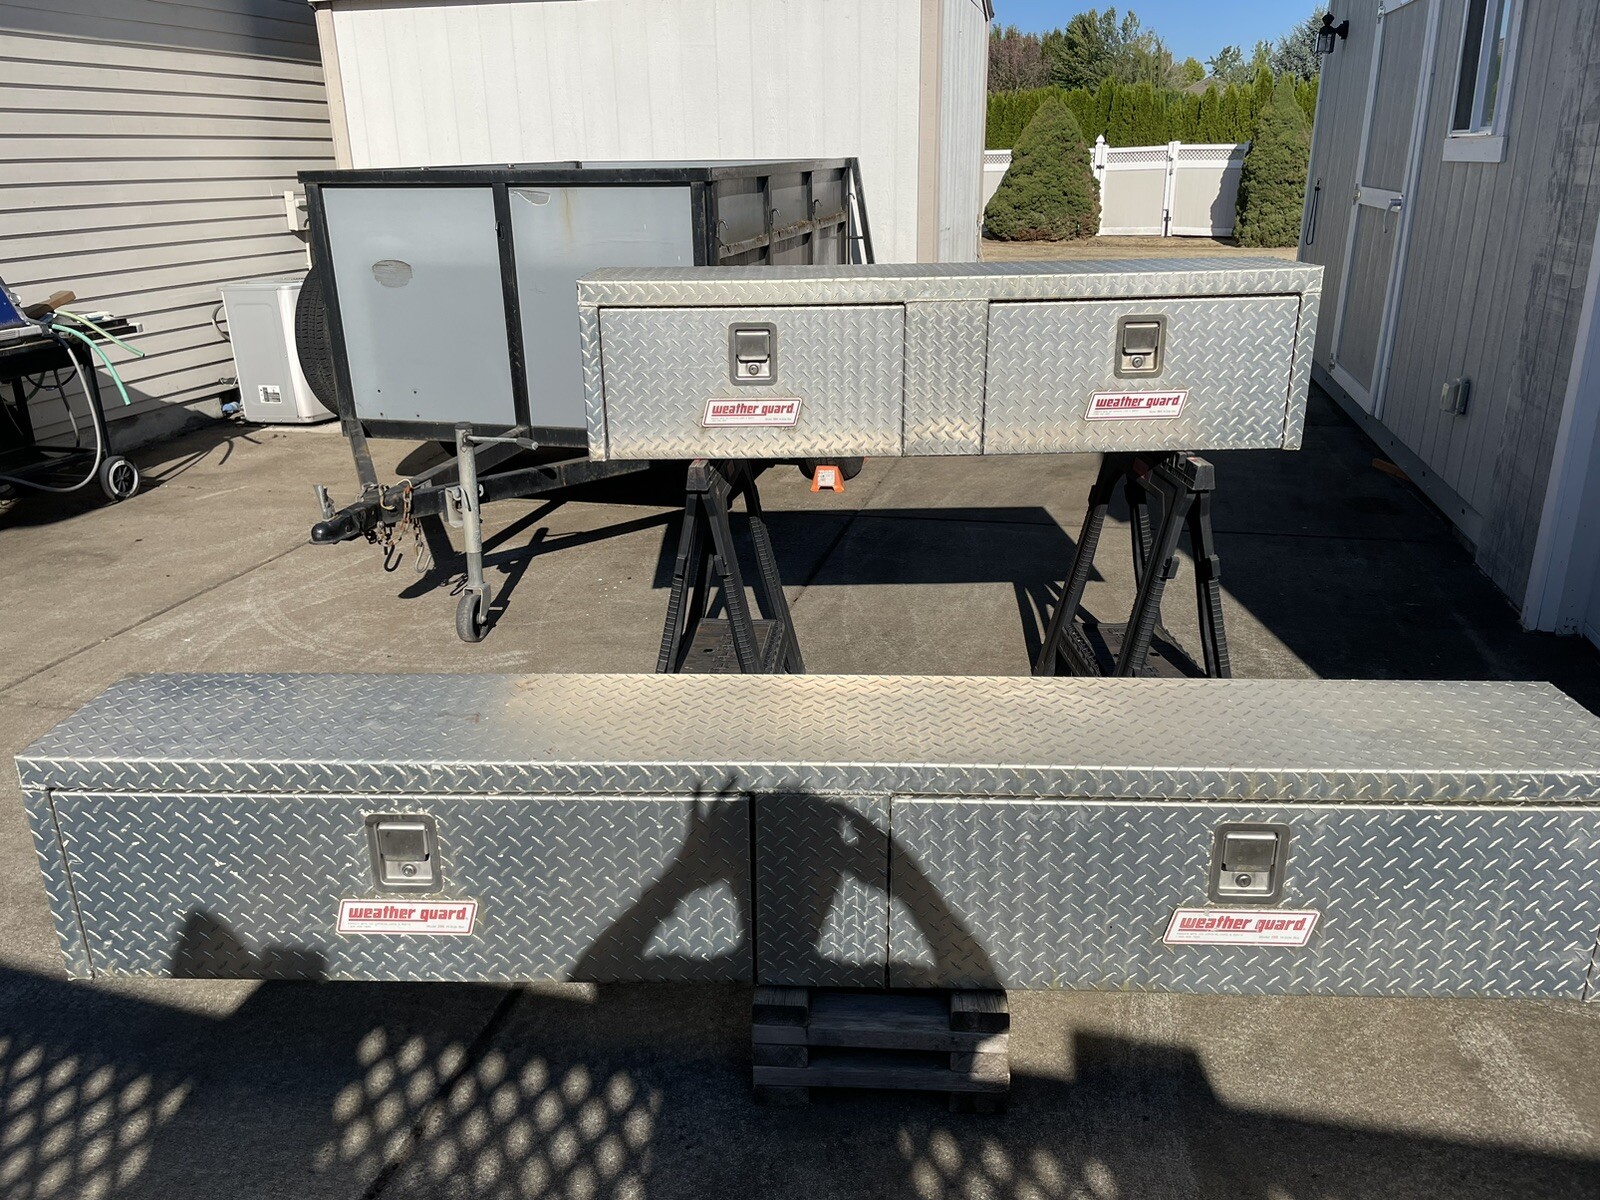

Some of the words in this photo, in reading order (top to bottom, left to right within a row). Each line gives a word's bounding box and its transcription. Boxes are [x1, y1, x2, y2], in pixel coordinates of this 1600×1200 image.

[1095, 396, 1144, 407] weather
[1146, 395, 1180, 408] guard
[711, 403, 759, 414] weather
[761, 403, 794, 416] guard
[348, 906, 416, 919] weather
[420, 907, 467, 922] guard
[1179, 916, 1252, 929] weather
[1255, 917, 1307, 933] guard
